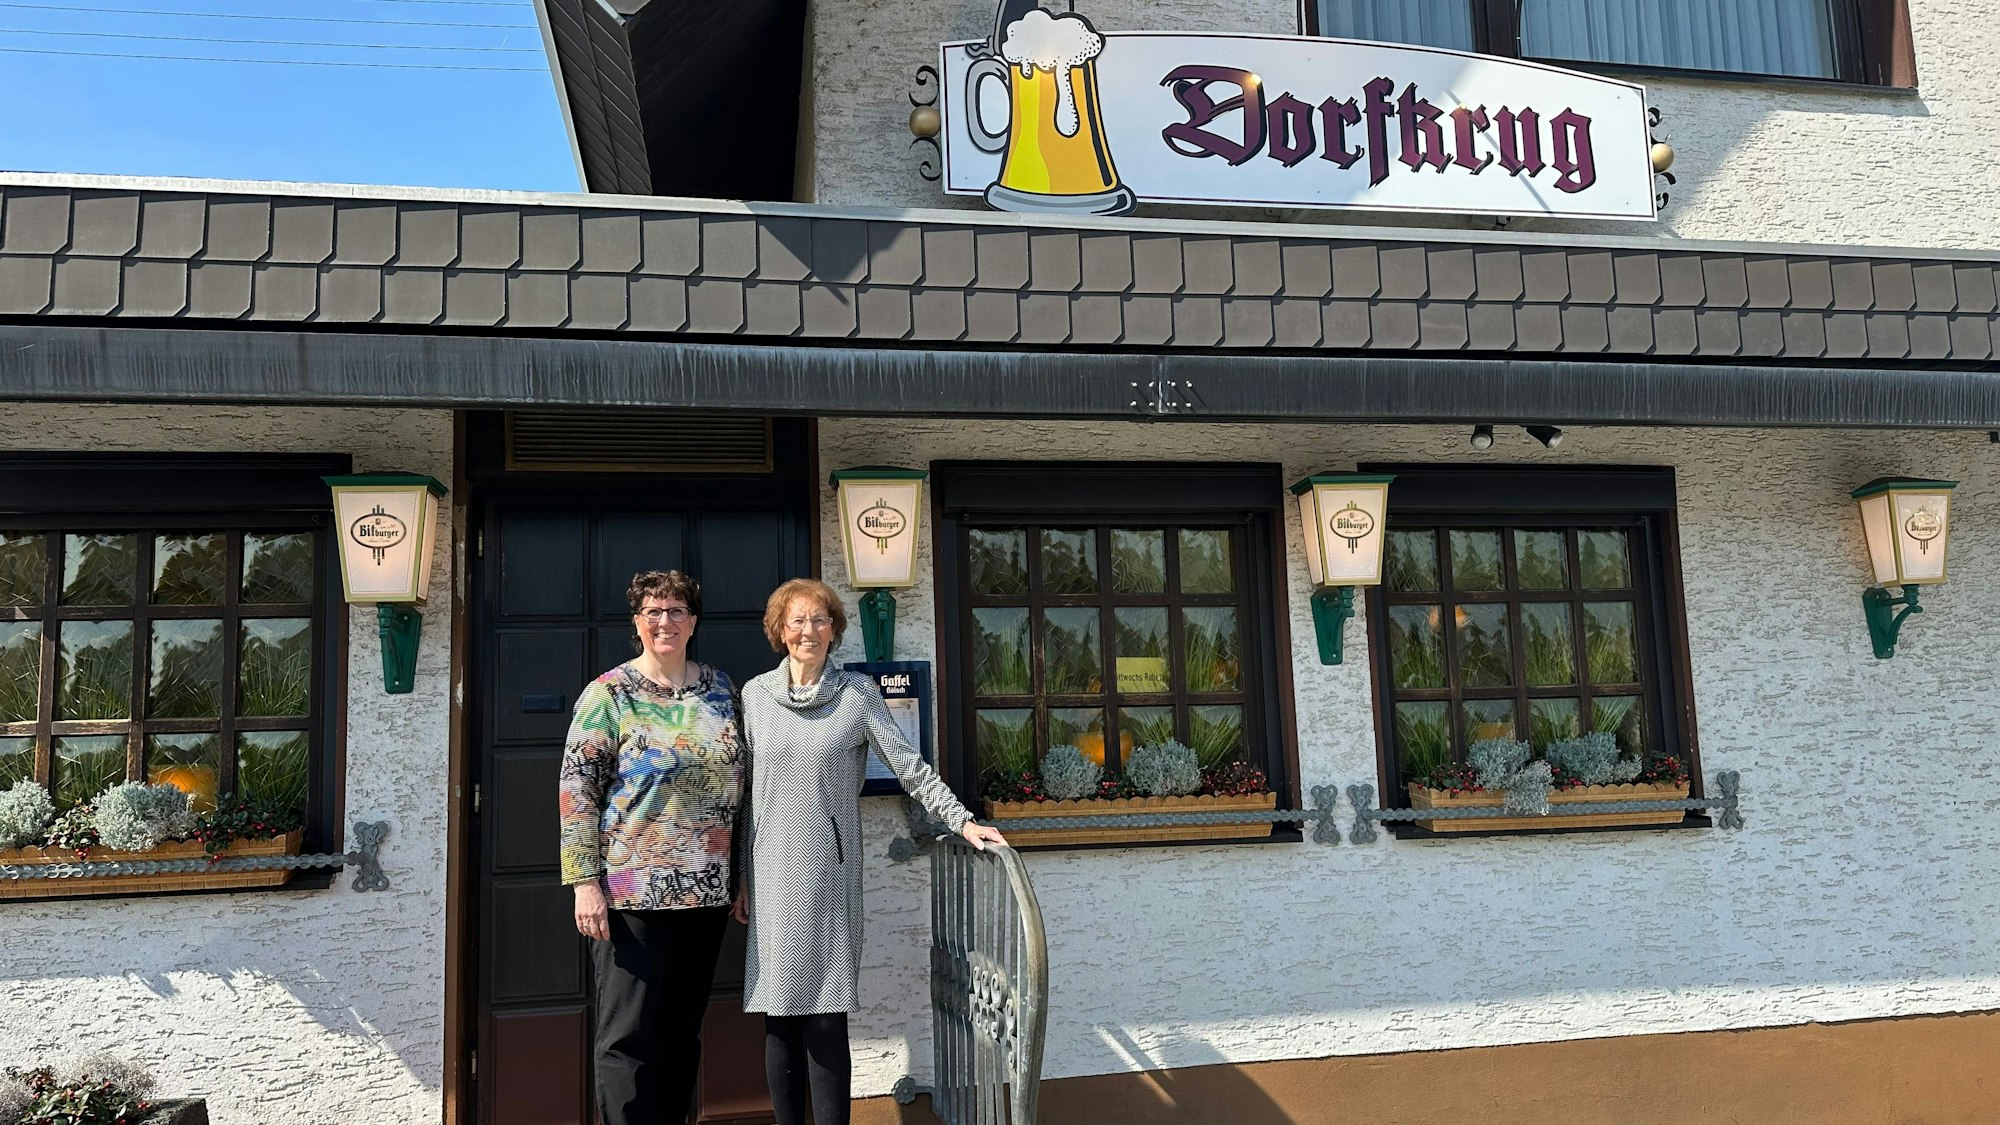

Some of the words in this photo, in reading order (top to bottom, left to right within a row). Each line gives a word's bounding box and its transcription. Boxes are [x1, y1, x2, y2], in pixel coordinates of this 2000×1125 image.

[1160, 64, 1597, 194] Dorfkrug
[865, 516, 900, 530] Bitburger
[1337, 518, 1369, 531] Bitburger
[359, 524, 399, 538] Bitburger
[880, 674, 911, 688] Gaffel
